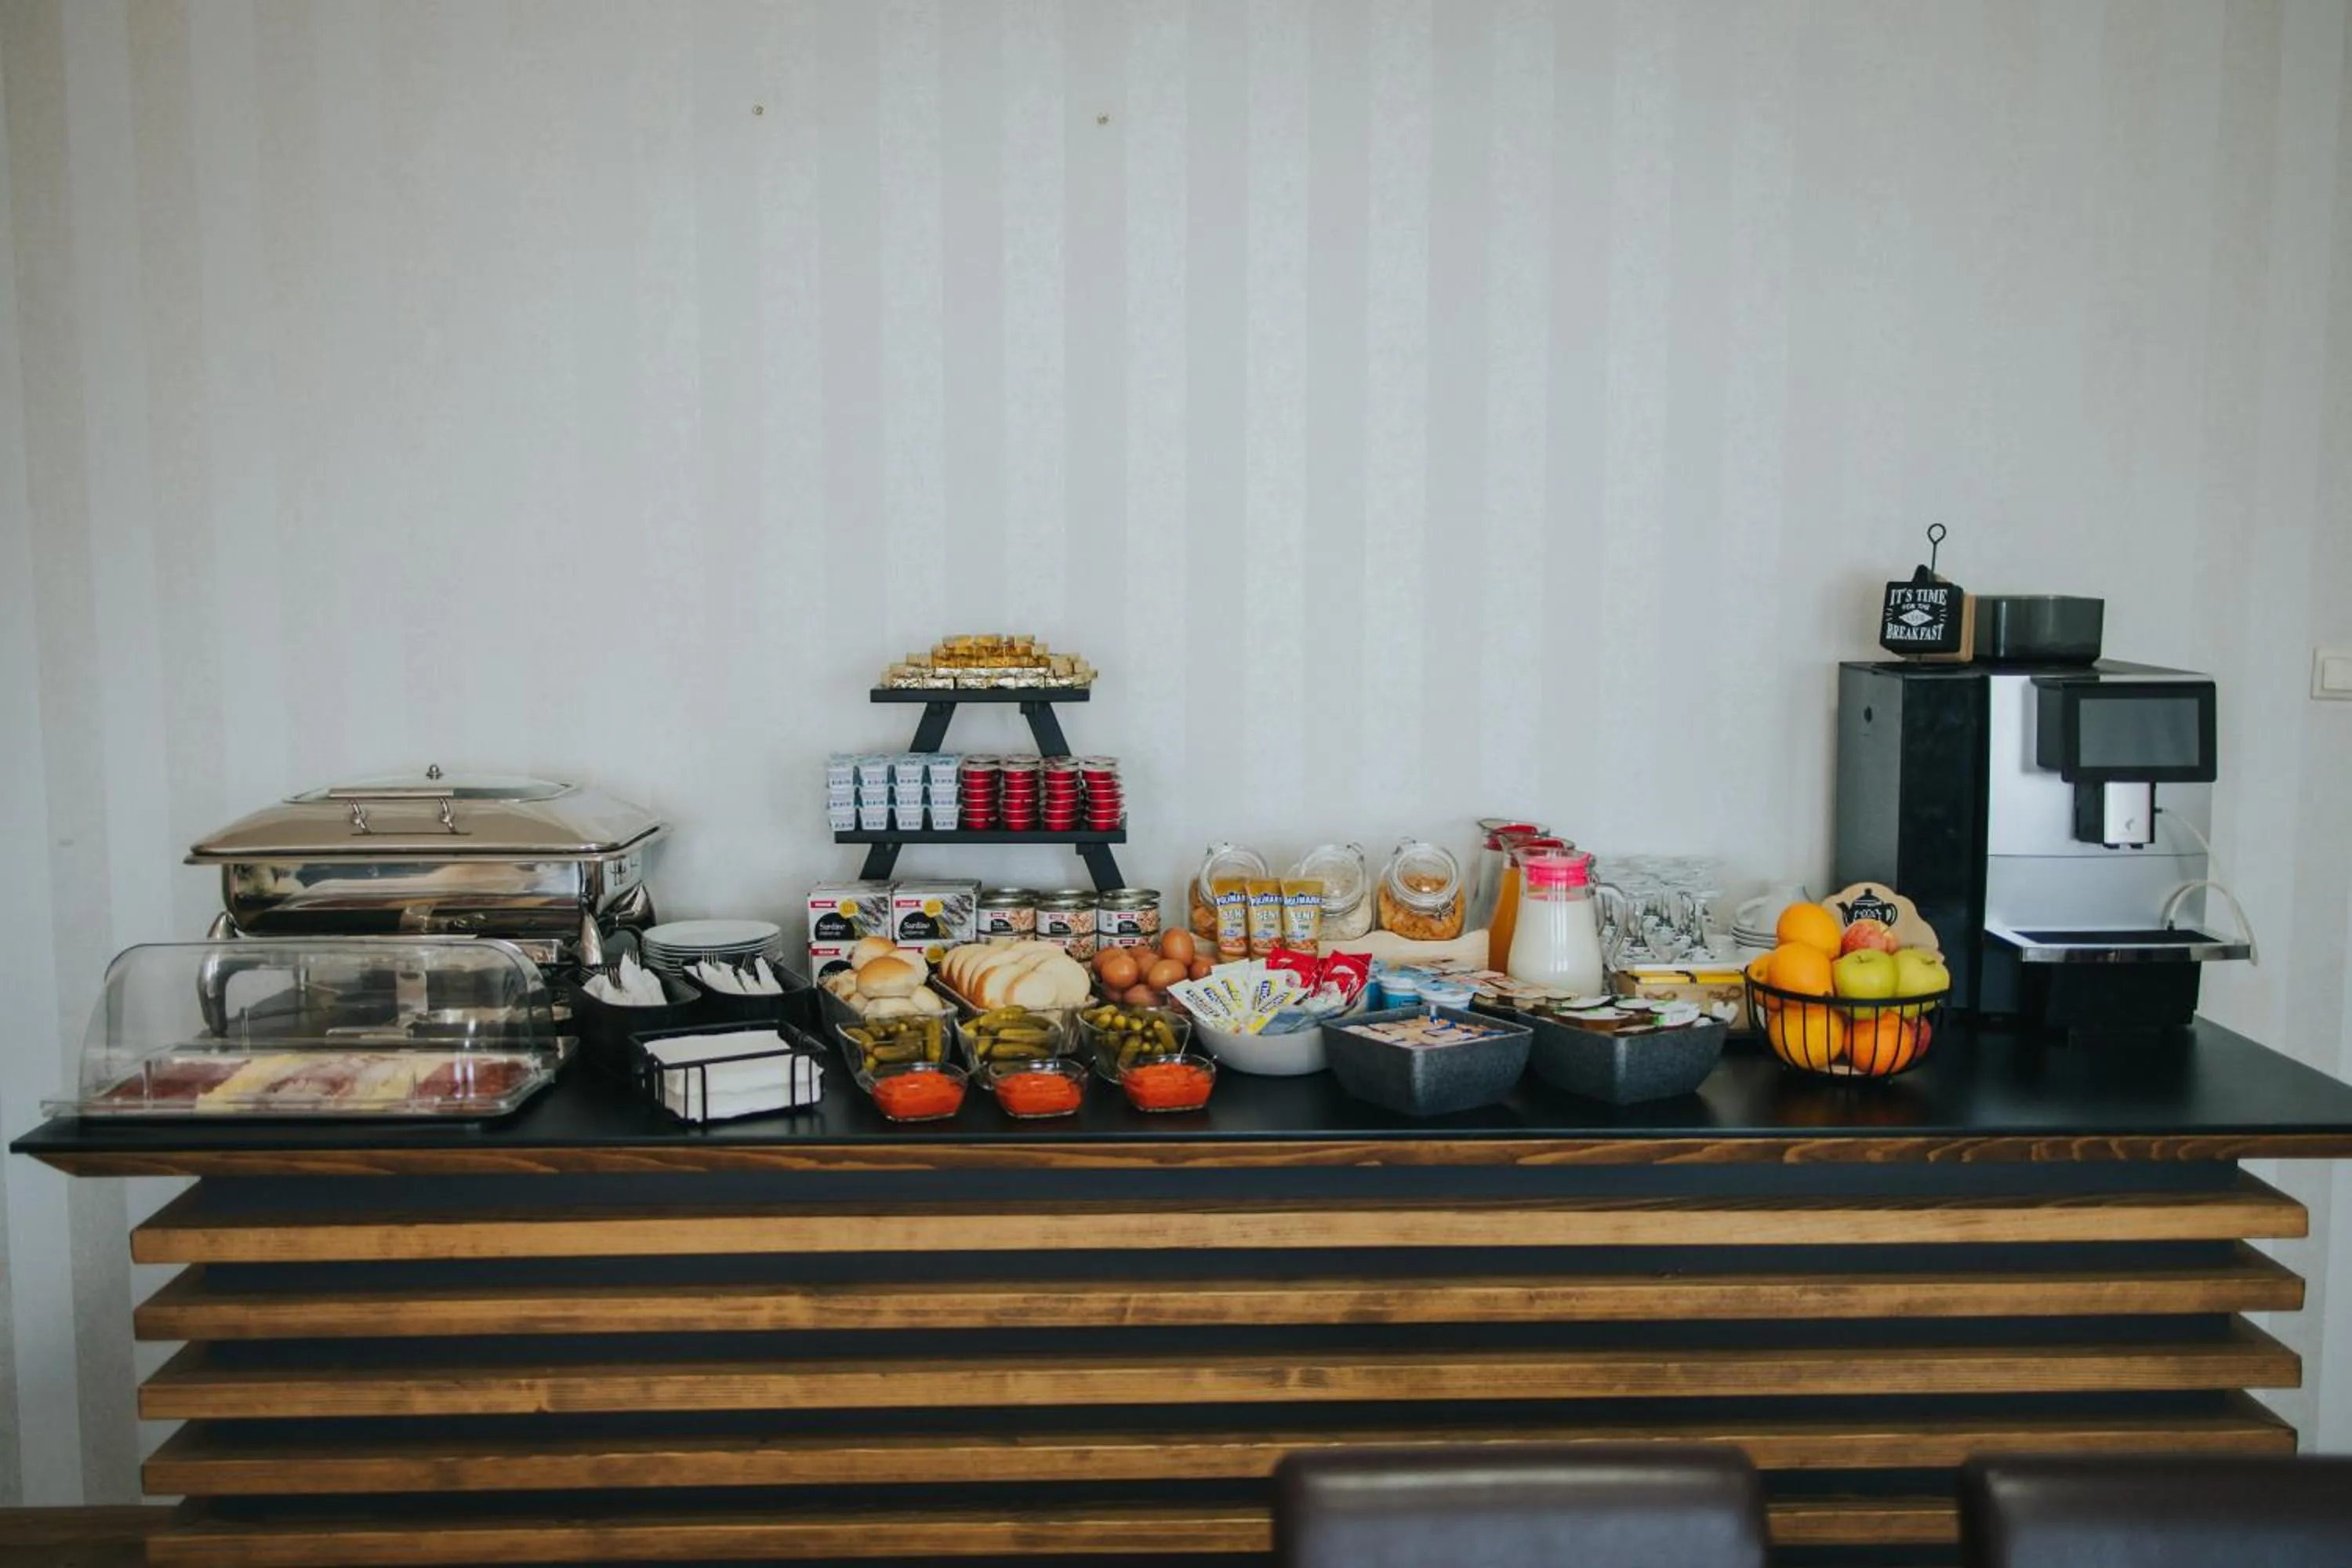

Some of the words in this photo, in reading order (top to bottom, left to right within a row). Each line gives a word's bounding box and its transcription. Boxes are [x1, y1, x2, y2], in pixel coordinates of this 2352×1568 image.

[1889, 588, 1914, 606] IT'S
[1915, 589, 1948, 606] TIME
[1886, 622, 1944, 641] BREAKFAST
